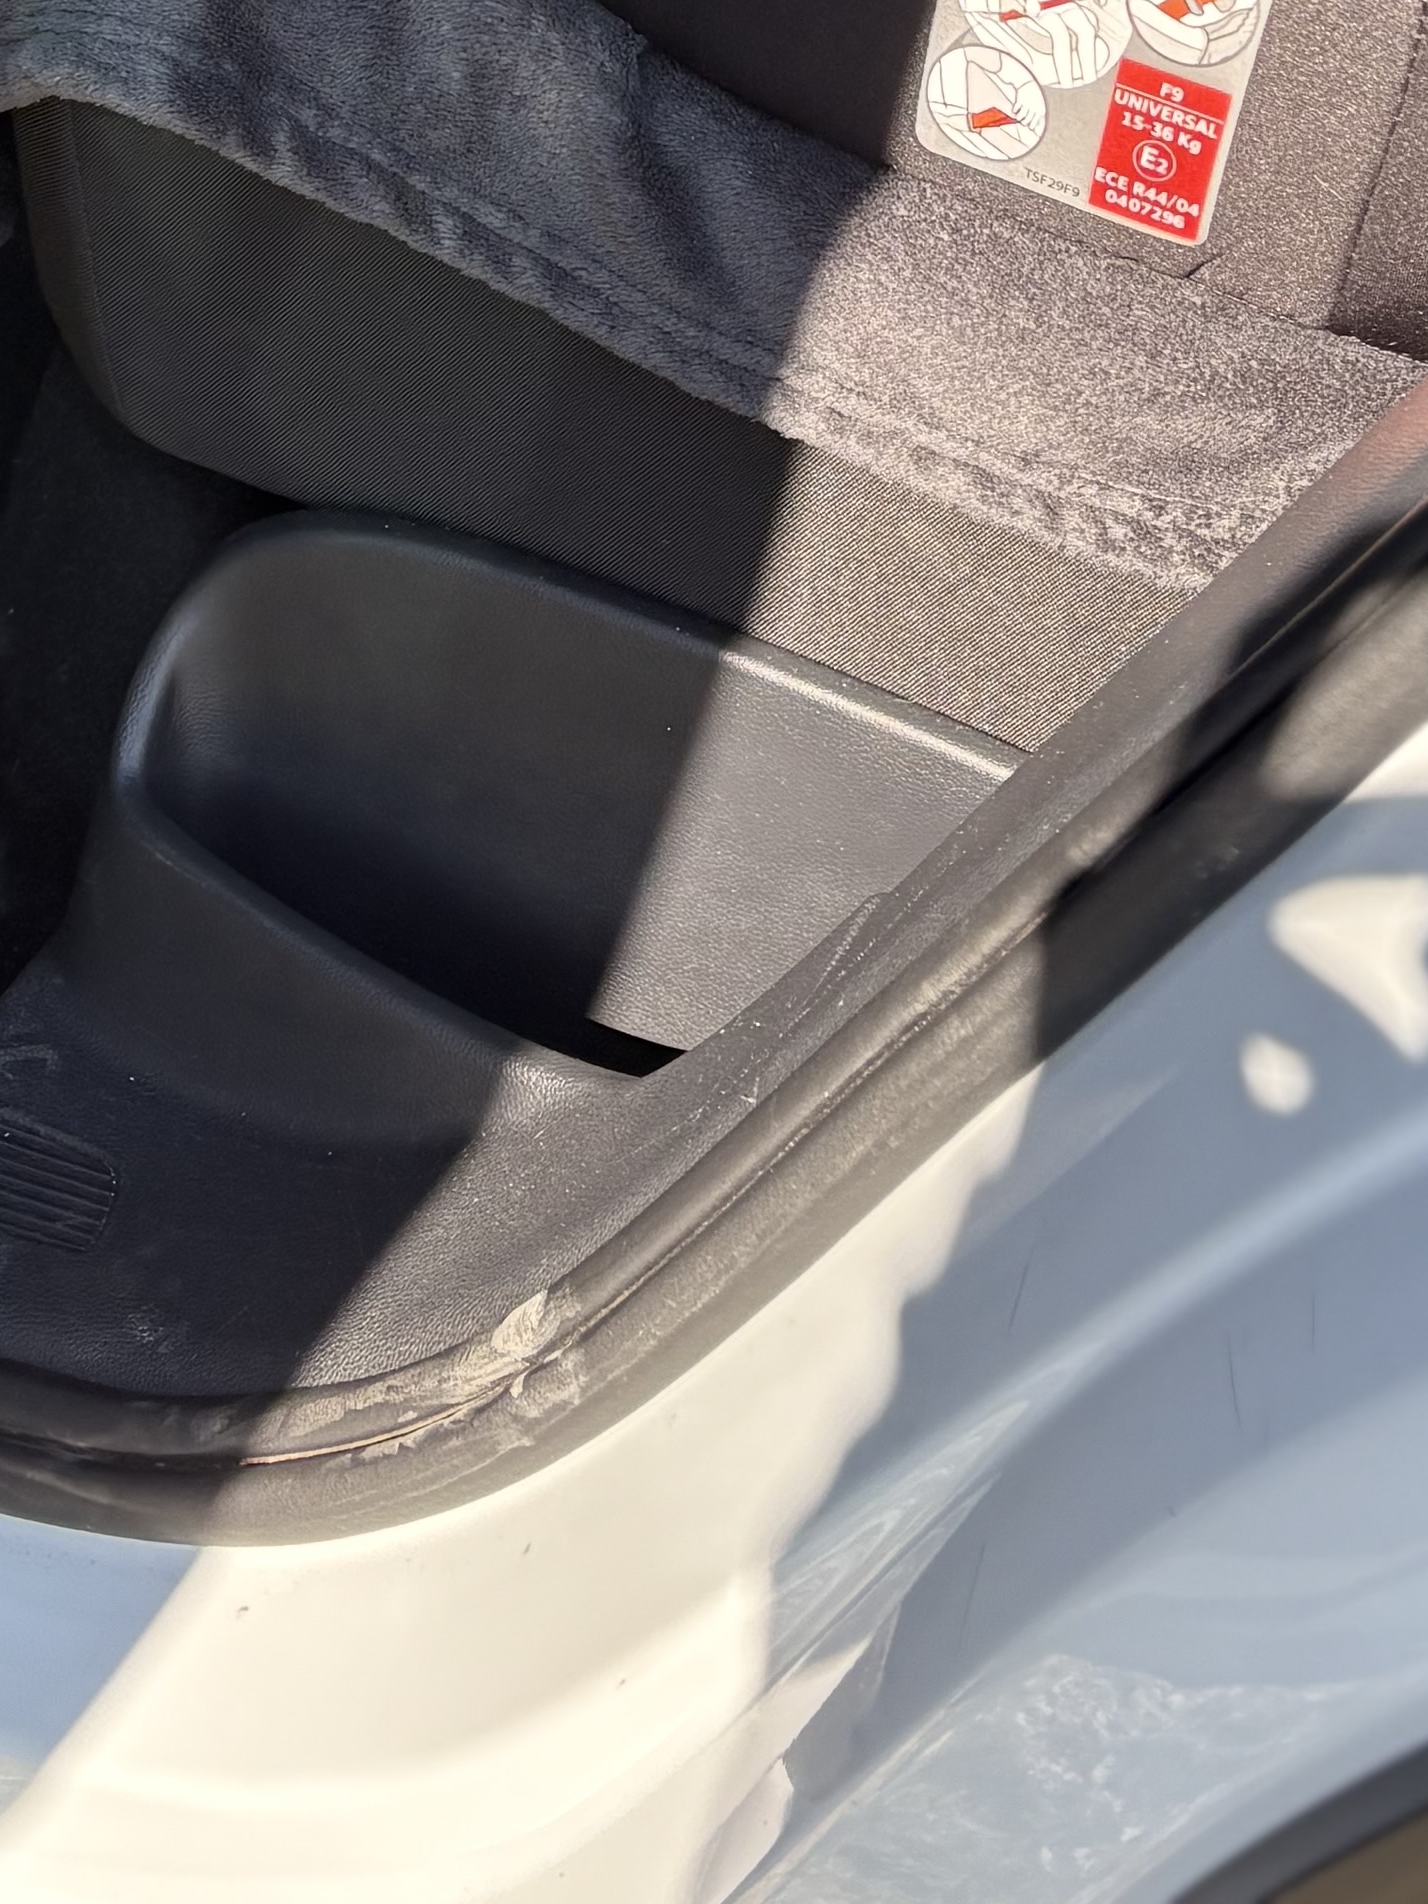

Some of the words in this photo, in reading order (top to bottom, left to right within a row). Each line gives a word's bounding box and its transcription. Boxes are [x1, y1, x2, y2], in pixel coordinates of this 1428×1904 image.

[1159, 82, 1185, 103] F9
[1113, 88, 1218, 140] UNIVERSAL
[1121, 111, 1175, 142] 15-36
[1177, 132, 1203, 156] Kg
[1139, 145, 1170, 176] E2
[1023, 166, 1081, 198] TSF29F9
[1094, 166, 1130, 192] ECE
[1132, 181, 1200, 218] R44/04
[1104, 189, 1186, 229] 0407296
